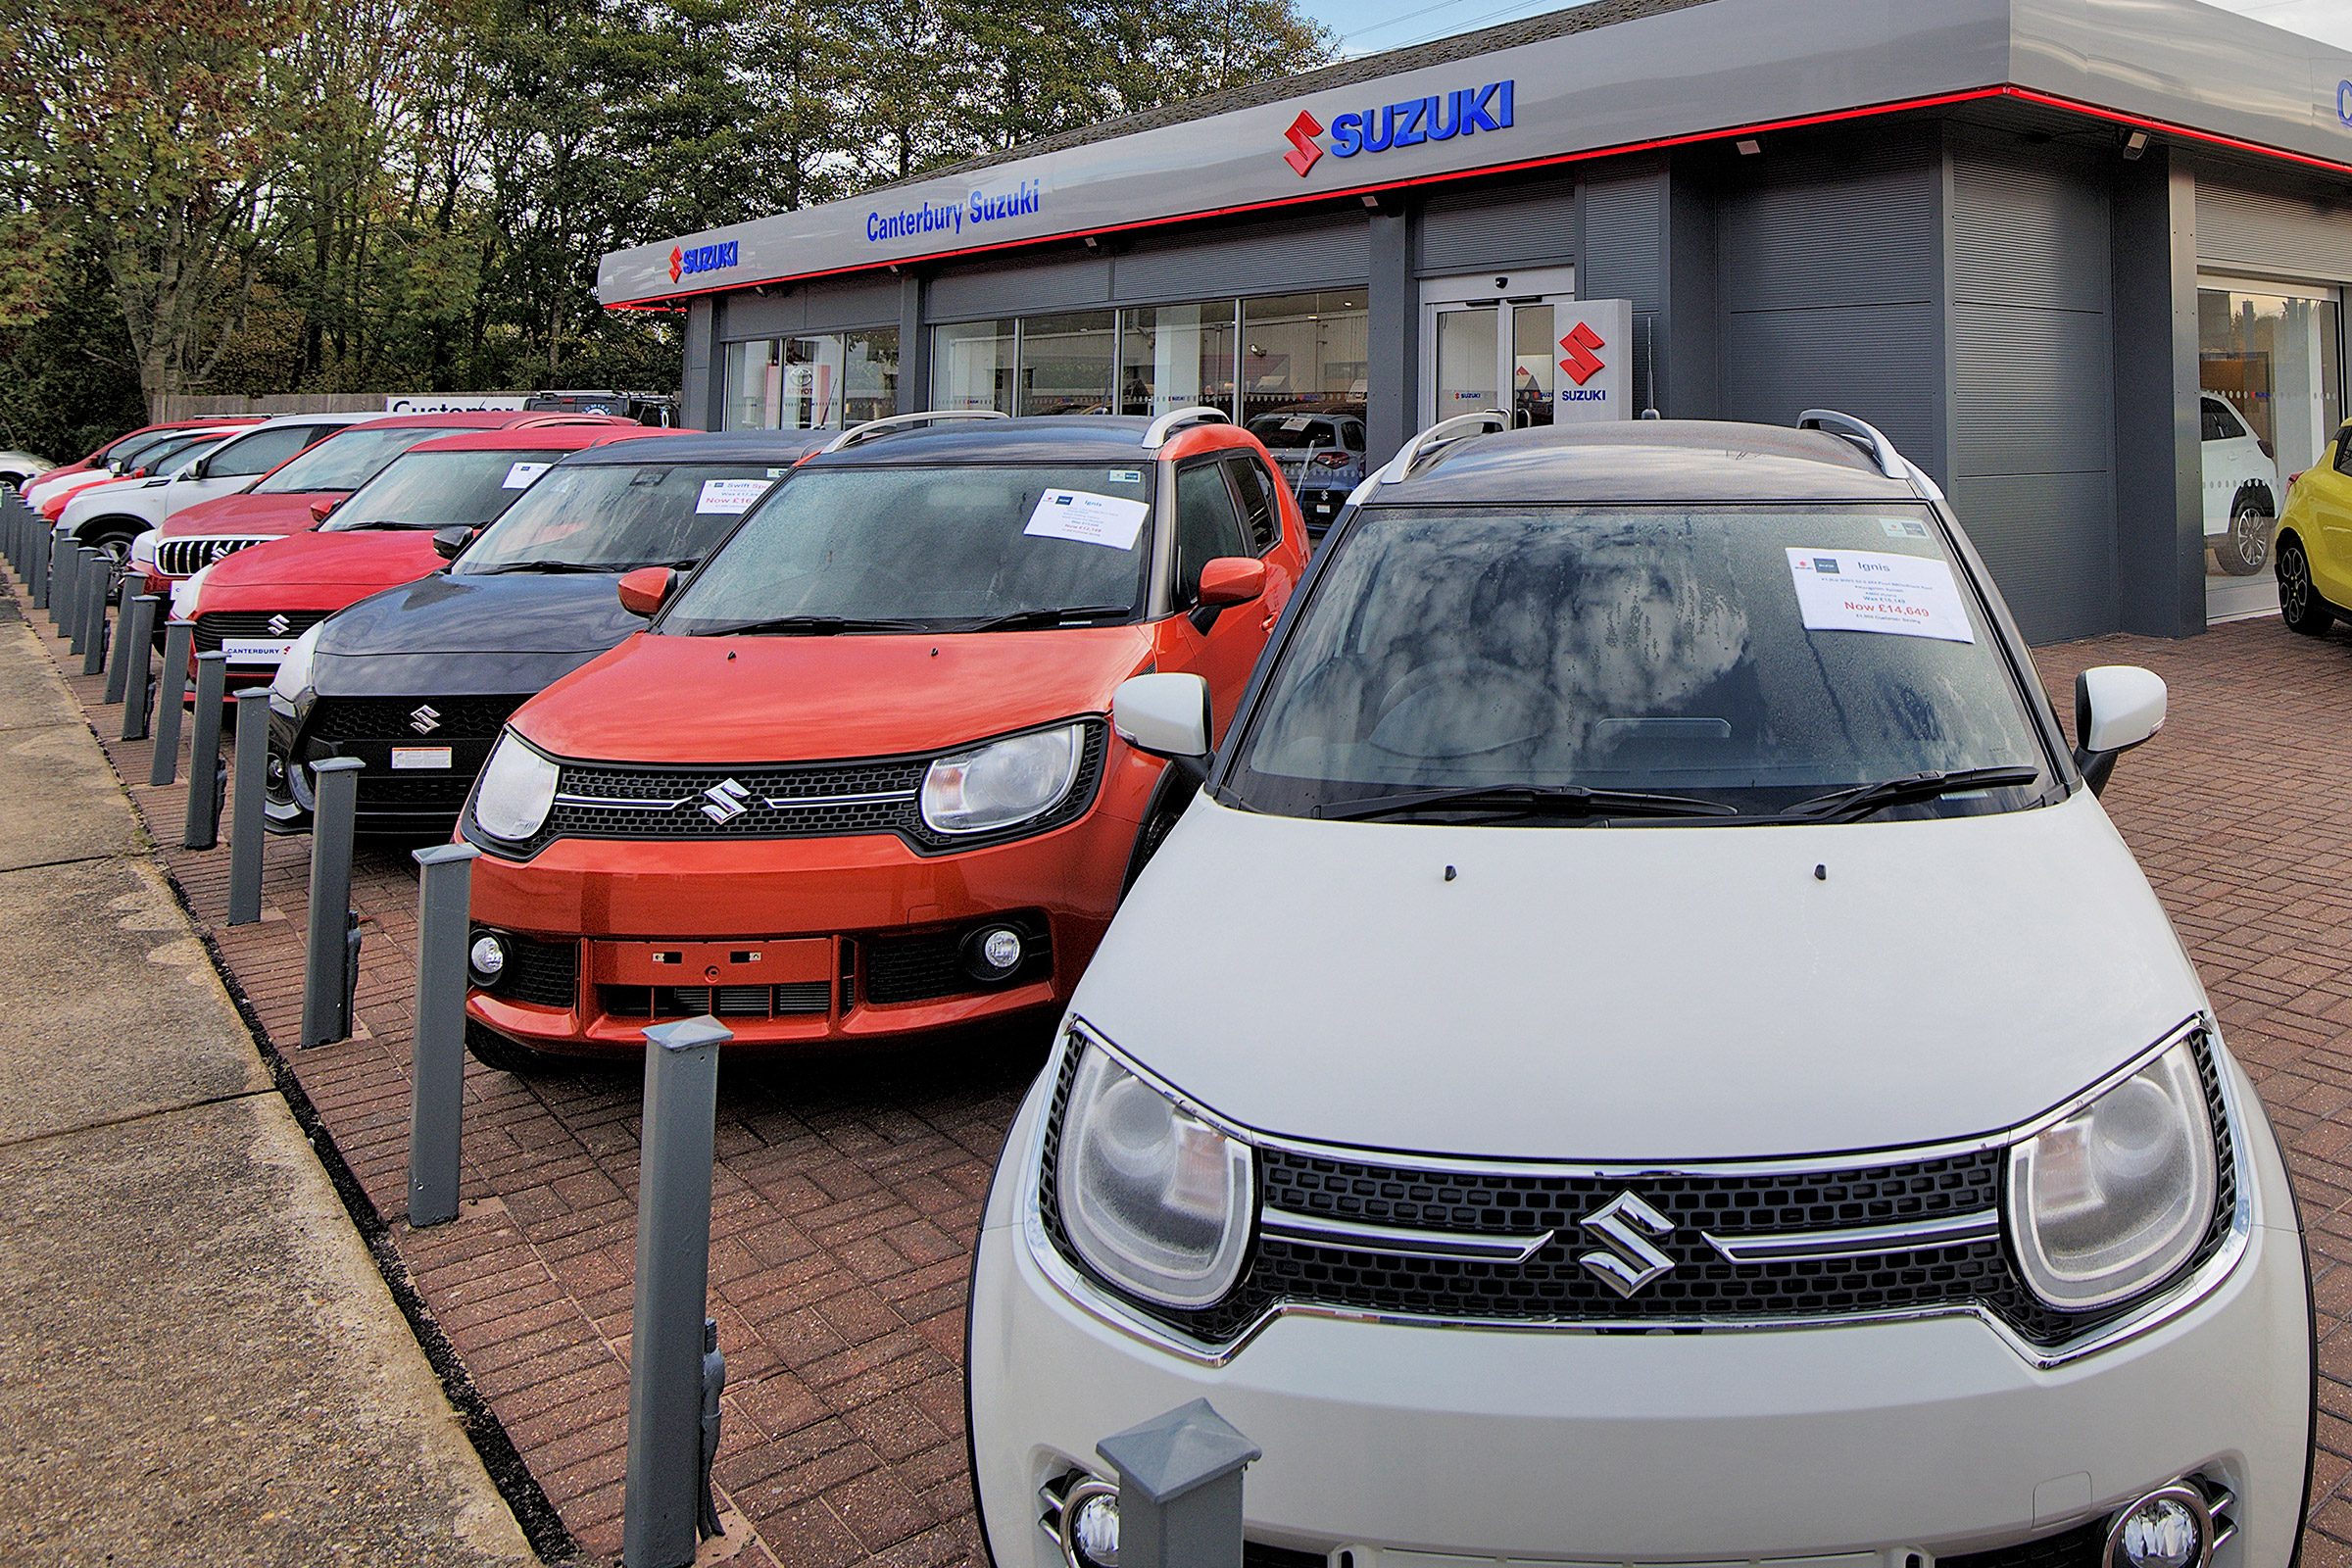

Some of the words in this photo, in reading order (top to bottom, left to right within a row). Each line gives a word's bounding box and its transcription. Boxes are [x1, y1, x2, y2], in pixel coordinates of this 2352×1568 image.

[1331, 79, 1514, 158] SUZUKI
[867, 202, 964, 242] Canterbury
[969, 178, 1040, 224] Suzuki
[683, 241, 739, 274] SUZUKI
[1562, 390, 1606, 401] SUZUKI
[1857, 562, 1890, 572] Ignis
[1843, 601, 1875, 612] Now
[1879, 604, 1930, 617] £14,649
